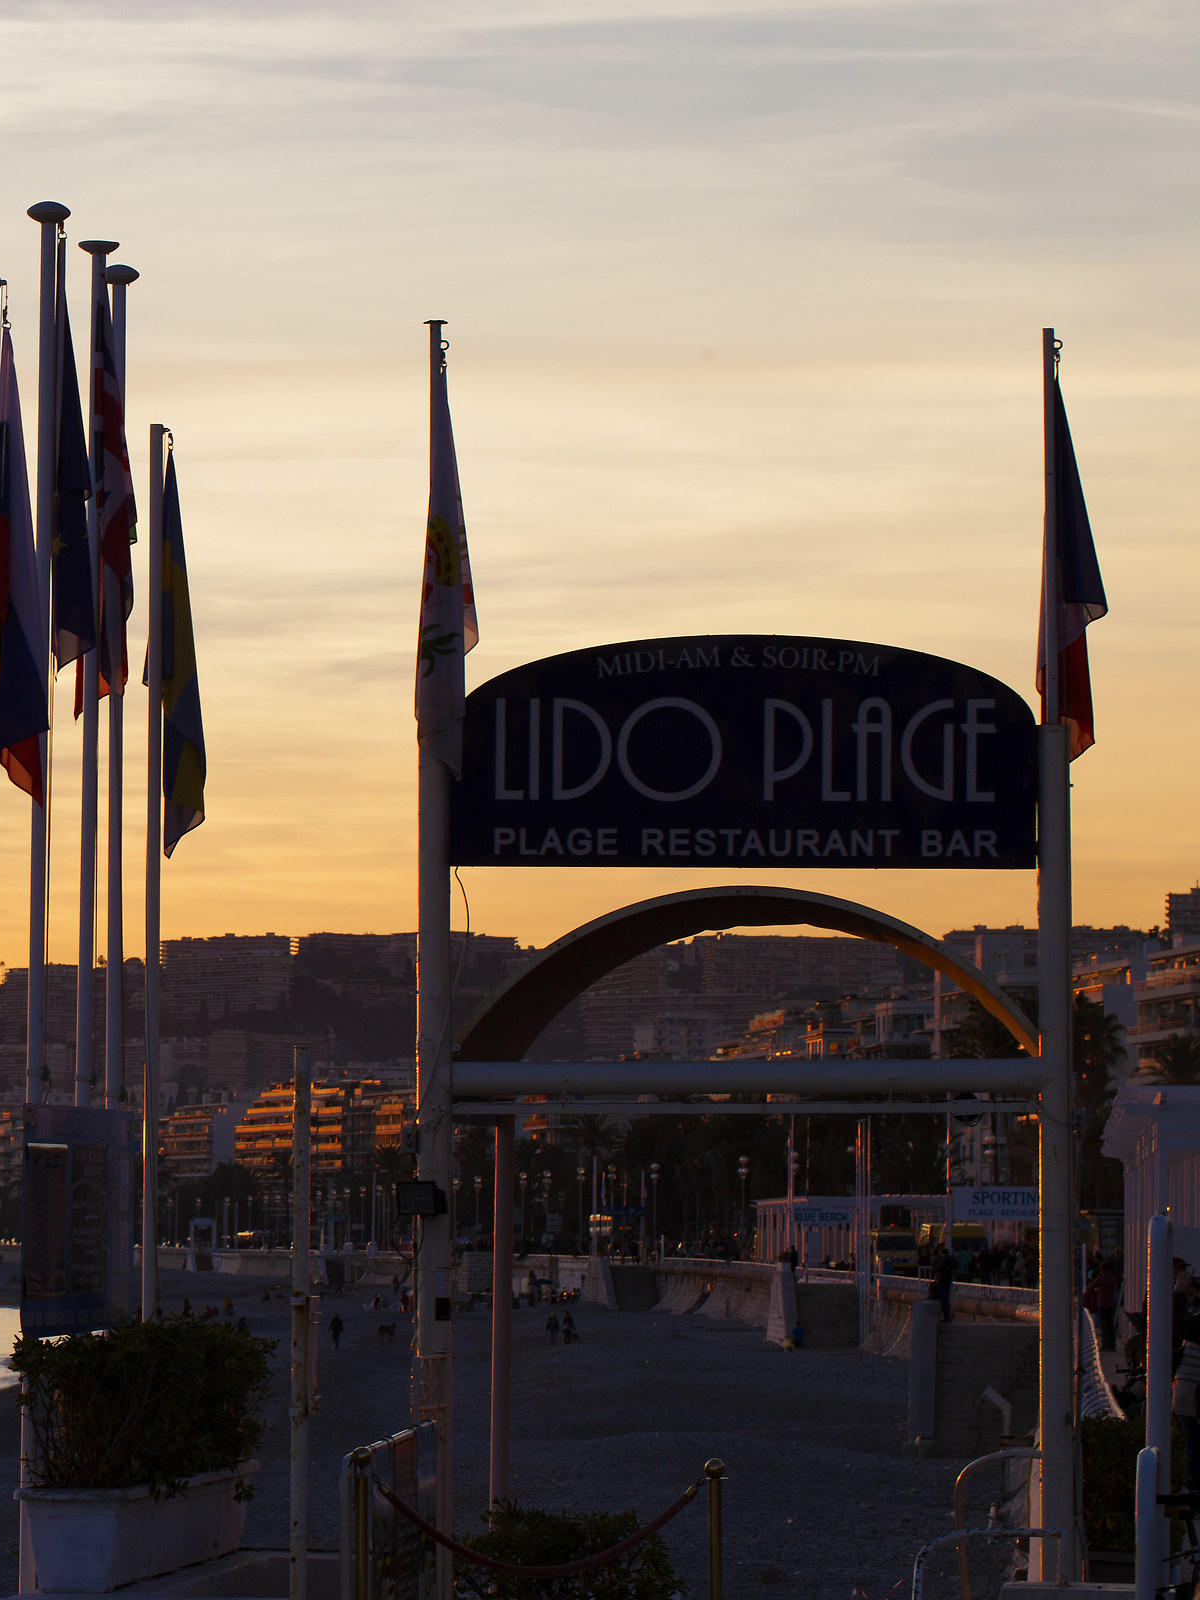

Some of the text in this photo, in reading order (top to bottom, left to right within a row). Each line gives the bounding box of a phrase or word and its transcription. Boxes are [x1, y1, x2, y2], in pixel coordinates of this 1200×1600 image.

[597, 646, 880, 678] MIDI-AM & SOIR-PM
[494, 697, 997, 802] LIDO PLAGE
[493, 828, 999, 858] PLAGE RESTAURANT BAR
[971, 1191, 1039, 1205] SPORTIN
[794, 1212, 848, 1222] BLUE BEACH
[968, 1208, 993, 1216] PLAGE
